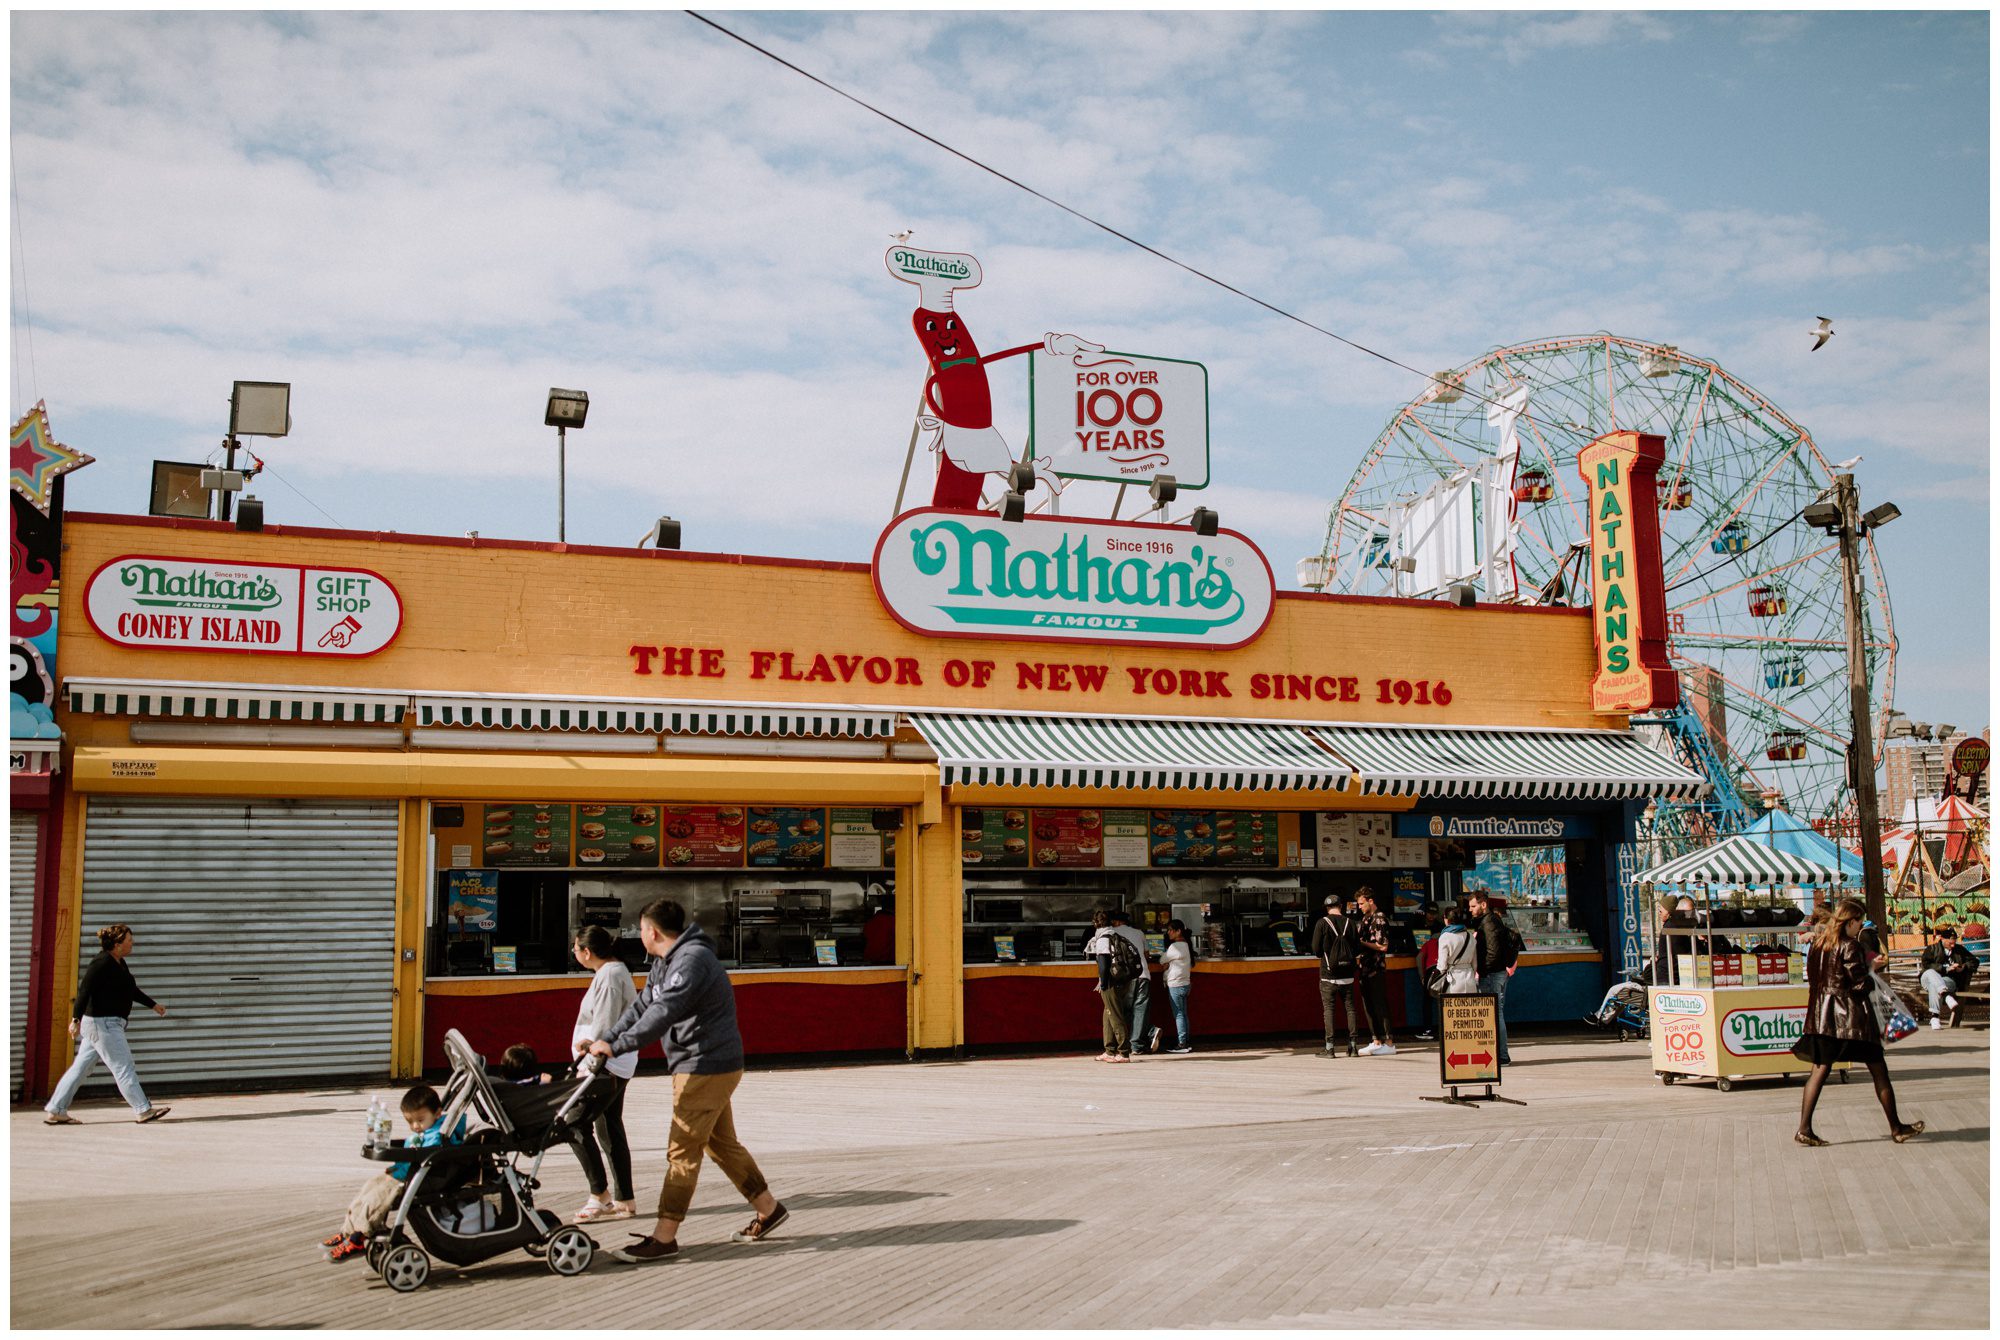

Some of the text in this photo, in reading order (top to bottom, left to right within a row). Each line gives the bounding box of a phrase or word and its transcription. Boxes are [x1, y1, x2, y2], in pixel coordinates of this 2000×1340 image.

[895, 251, 970, 275] Nathan's
[1077, 371, 1158, 385] FOR OVER
[1076, 387, 1163, 427] 100
[1075, 429, 1165, 452] YEARS
[1584, 438, 1632, 464] ORIGINAL
[1140, 462, 1155, 472] 1916
[1107, 538, 1174, 555] Since 1916
[910, 520, 1243, 608] Nathan's
[1597, 458, 1629, 674] NATHANS
[120, 564, 281, 601] Nathan's
[214, 571, 232, 579] Since
[316, 576, 371, 597] GIFT
[176, 602, 230, 610] FAMOUS
[316, 596, 371, 613] SHOP
[118, 613, 281, 644] CONEY ISLAND
[1032, 614, 1140, 630] FAMOUS
[629, 645, 1452, 706] THE FLAVOR OF NEW YORK SINCE 1916
[1601, 674, 1640, 689] FAMOUS
[1956, 747, 1989, 759] ELECTRO
[1961, 760, 1980, 773] SPIN
[460, 886, 497, 896] CHEESE
[1453, 997, 1494, 1007] CONSUMPTION
[1658, 995, 1702, 1009] Nathan's
[1447, 1008, 1489, 1018] OF BEER IS NOT
[1453, 1019, 1485, 1029] PERMITTED
[1681, 1023, 1701, 1031] OVER
[1445, 1030, 1494, 1040] PAST THIS POINT!
[1665, 1032, 1703, 1051] 100
[1666, 1051, 1705, 1062] YEARS
